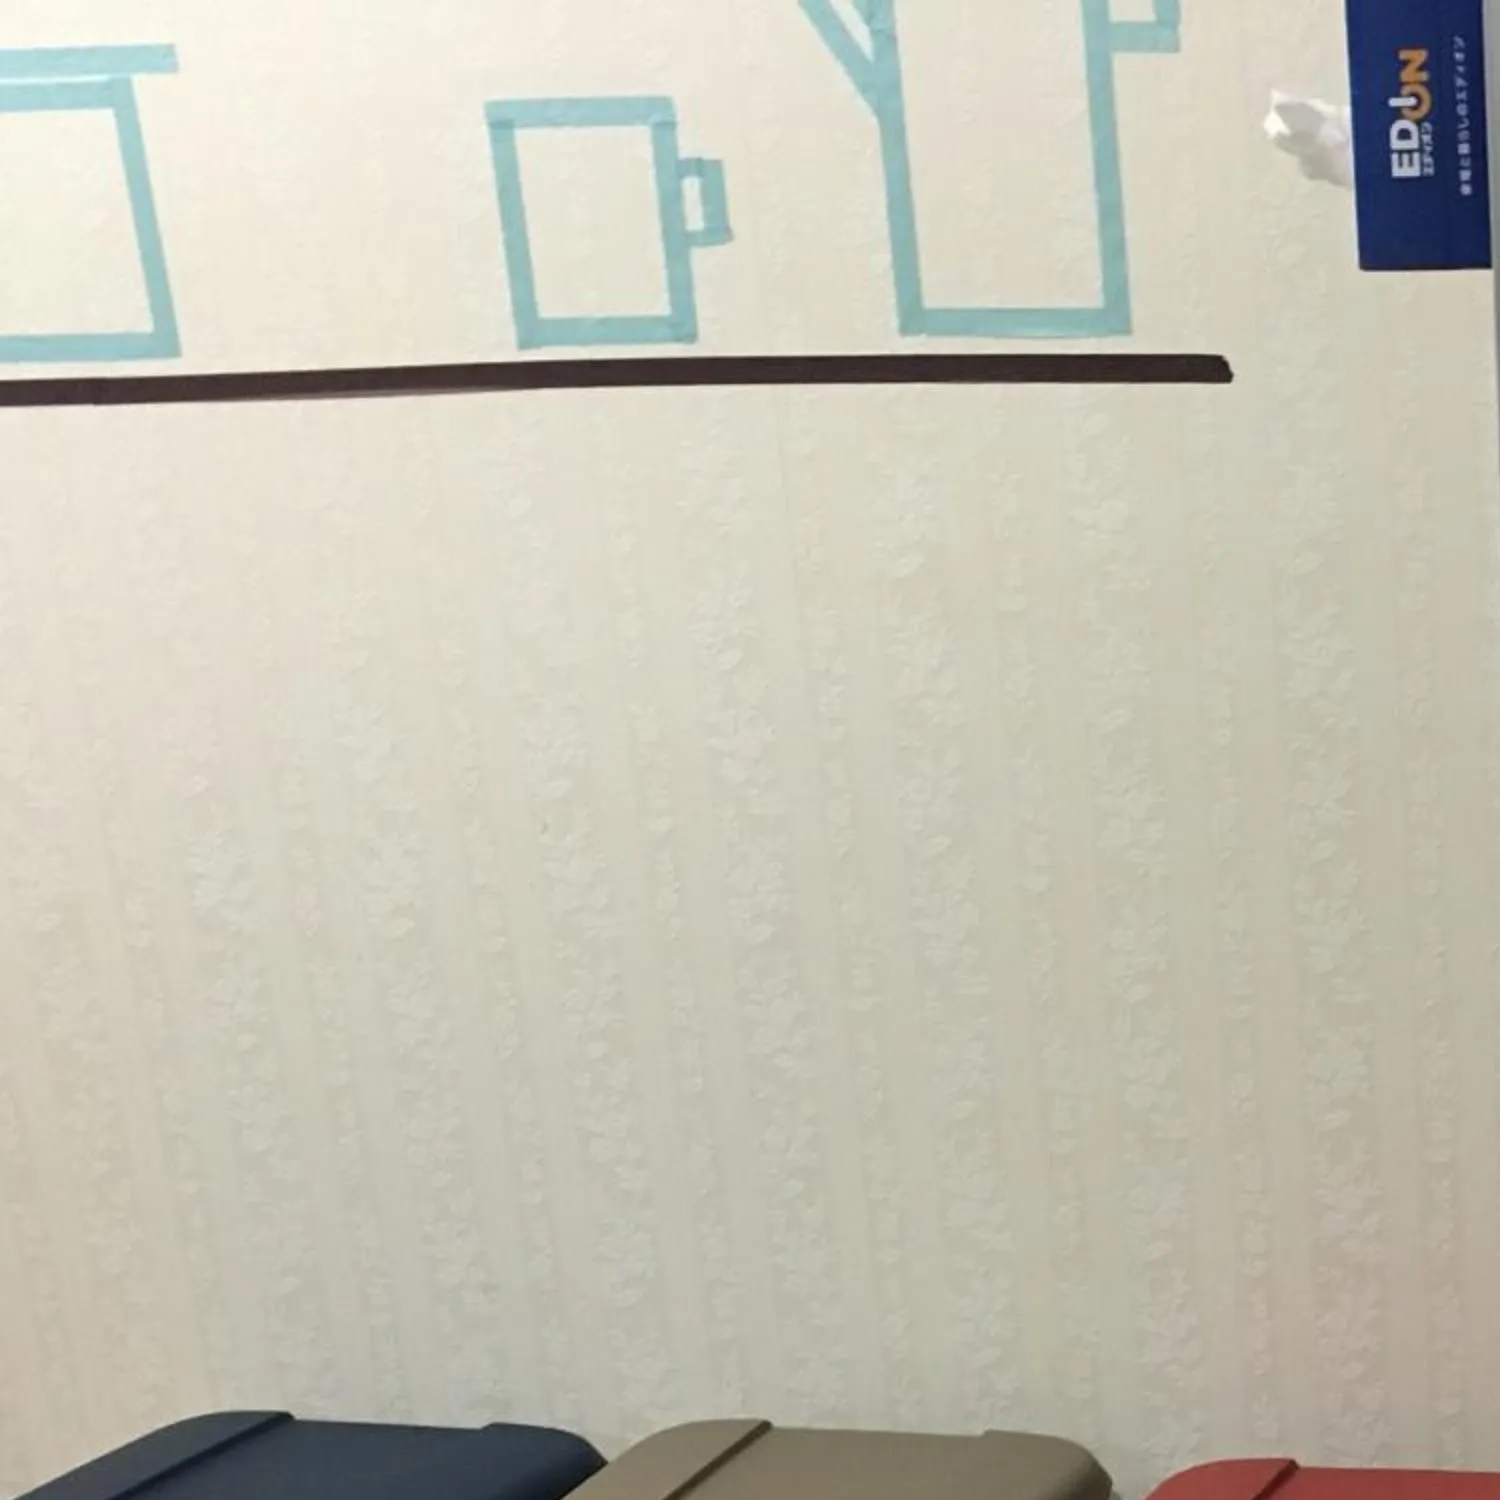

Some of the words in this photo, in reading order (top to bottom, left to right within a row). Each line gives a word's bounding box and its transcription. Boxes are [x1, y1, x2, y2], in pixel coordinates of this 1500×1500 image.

[1388, 48, 1432, 178] EDION
[1420, 121, 1434, 177] エディオン
